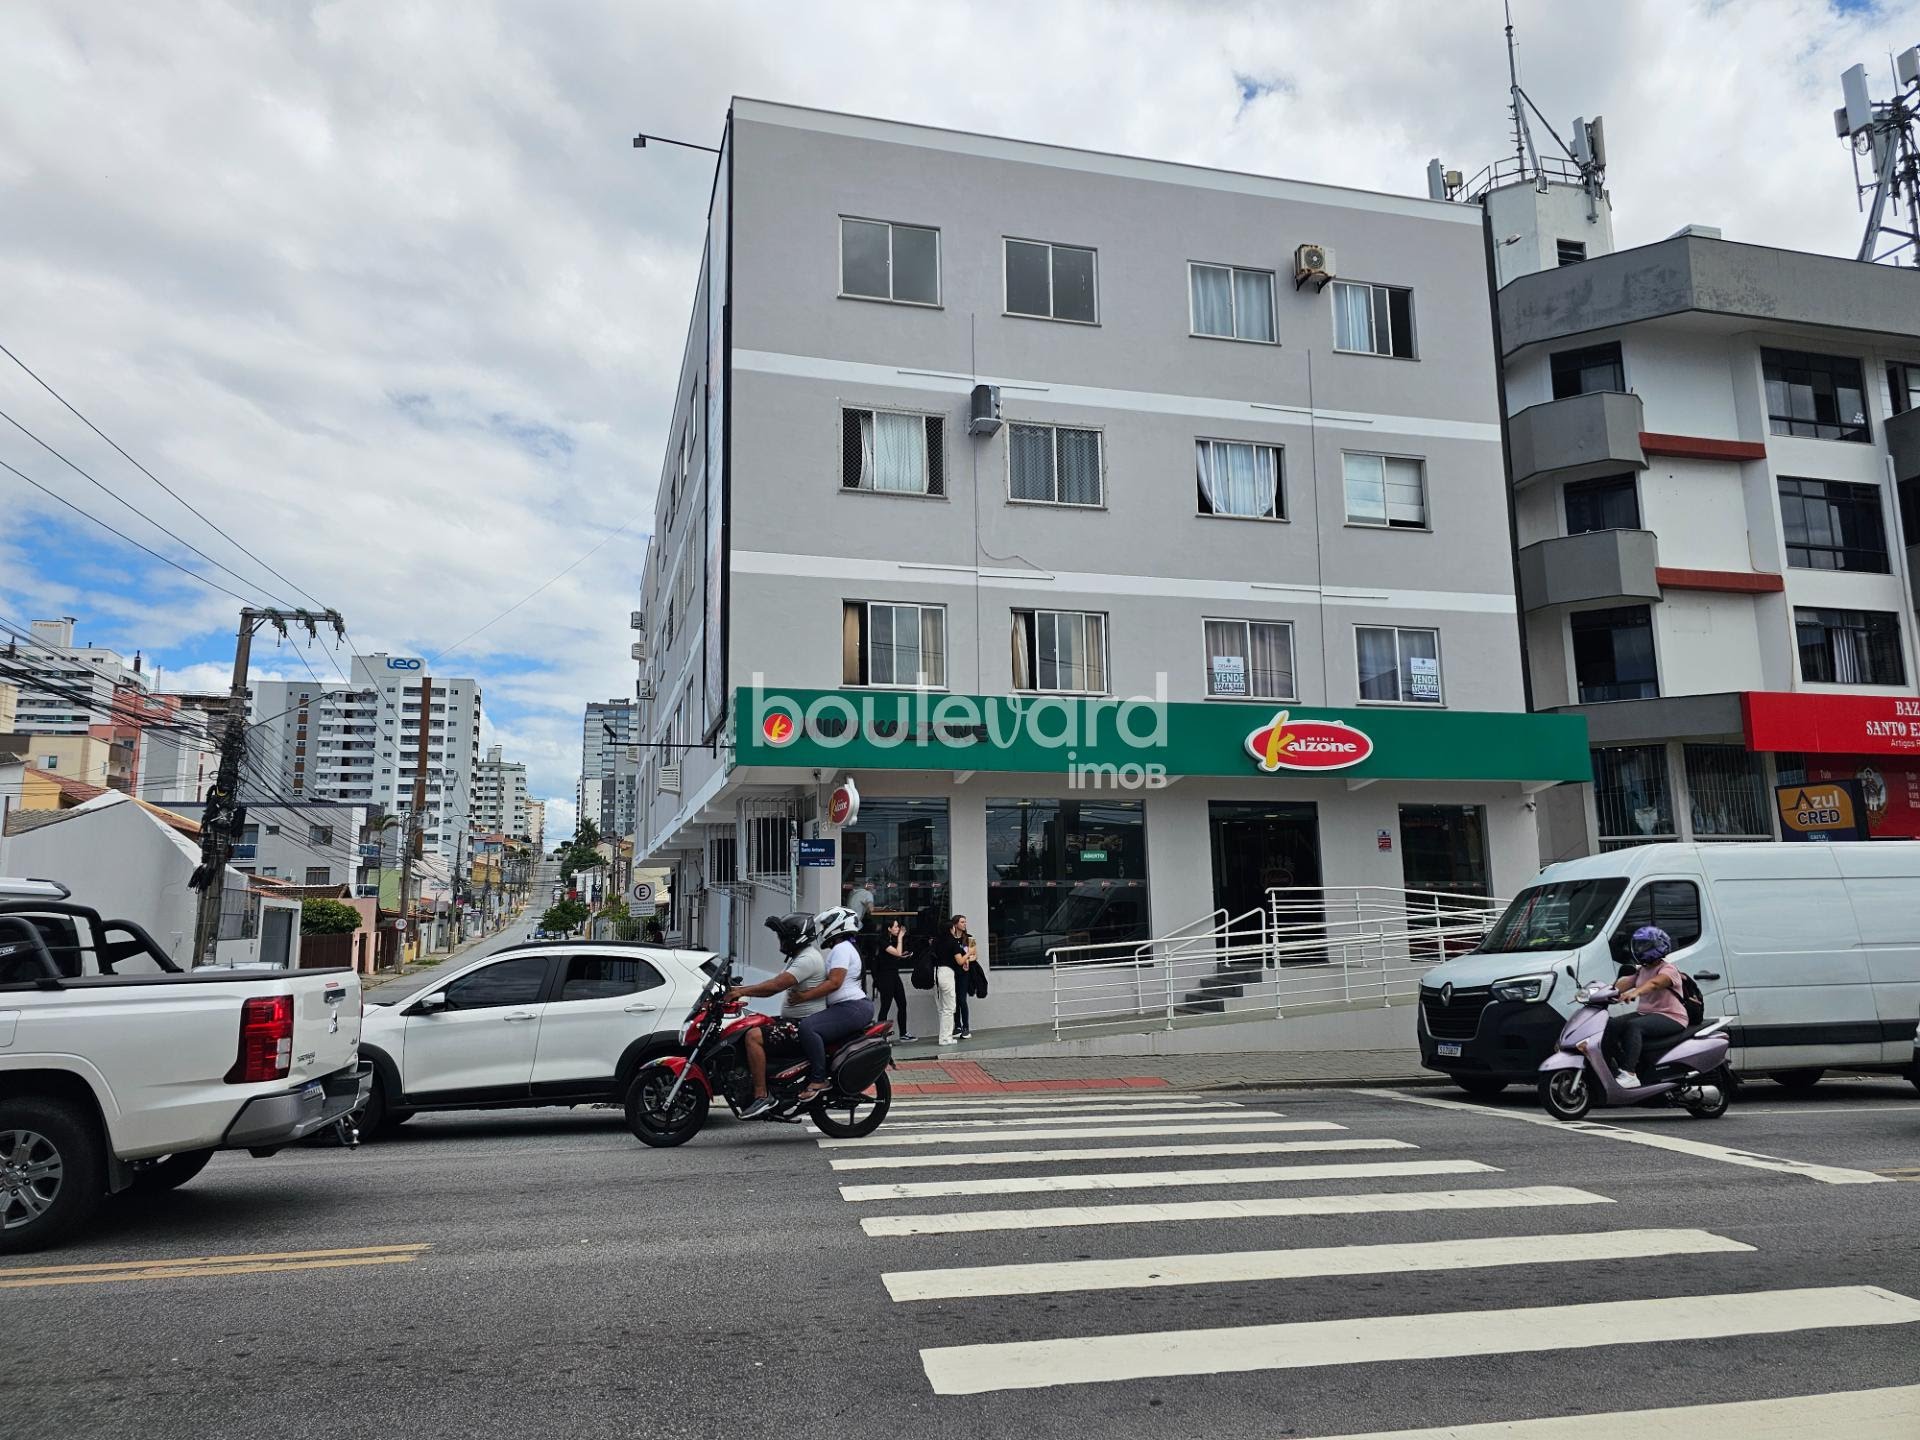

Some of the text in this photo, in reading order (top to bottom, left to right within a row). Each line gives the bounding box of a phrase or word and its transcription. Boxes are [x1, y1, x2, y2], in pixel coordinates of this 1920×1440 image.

[1215, 672, 1245, 683] VENDE
[1411, 674, 1438, 685] VENDE
[868, 719, 989, 744] KALZONE
[1865, 720, 1907, 736] SANTO
[1890, 738, 1915, 748] Artigos
[1797, 809, 1841, 826] CRED
[638, 886, 647, 898] E
